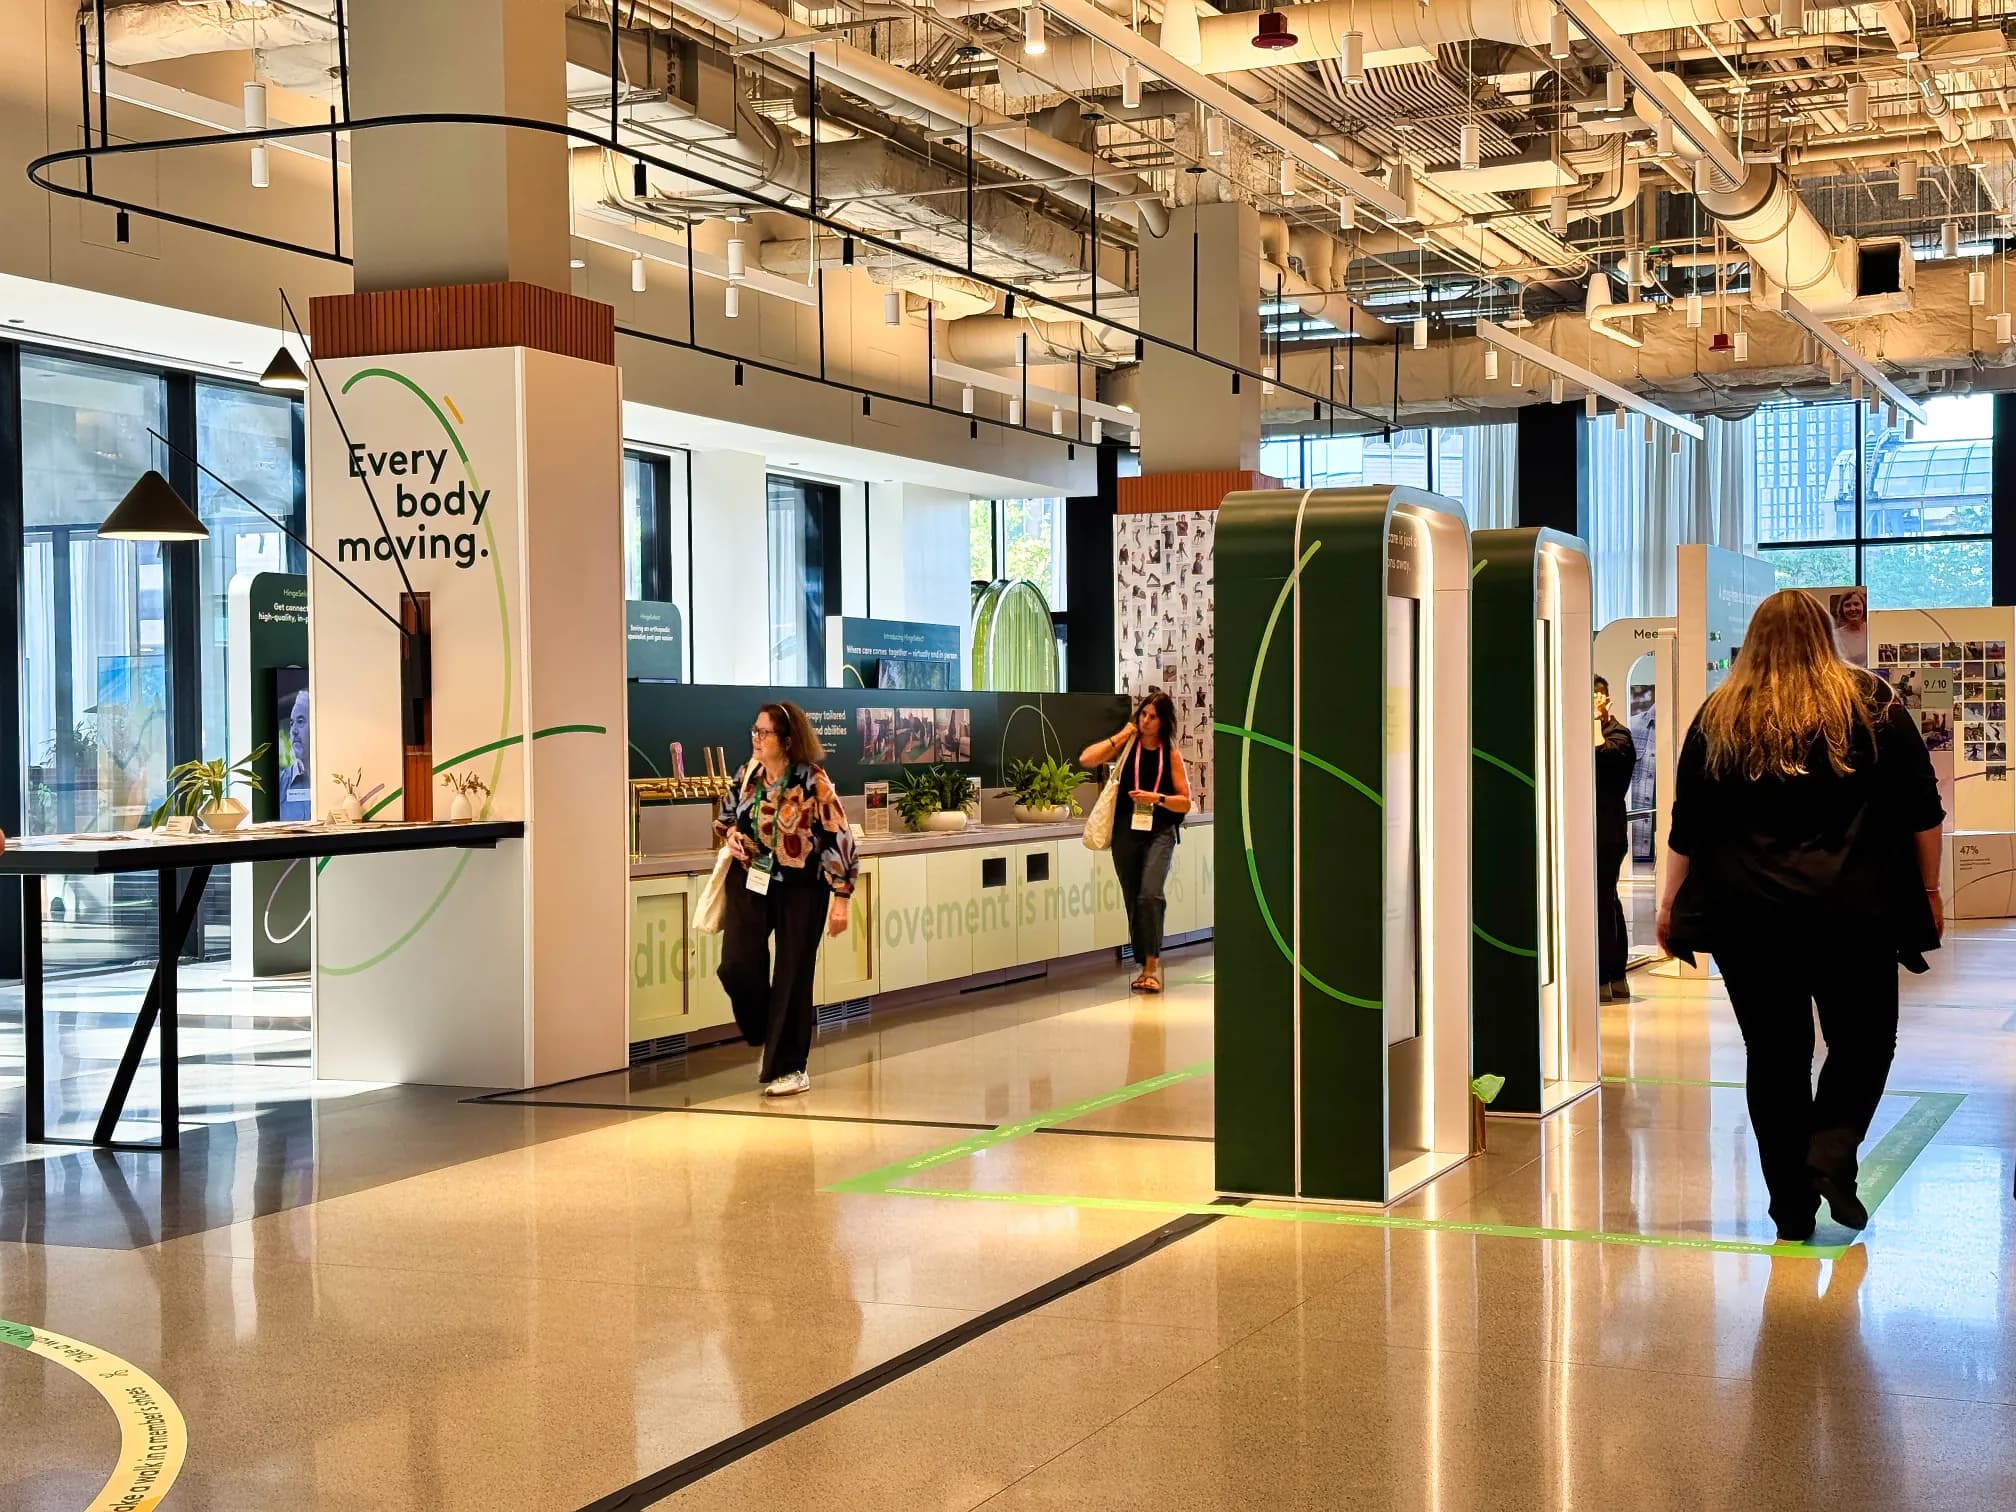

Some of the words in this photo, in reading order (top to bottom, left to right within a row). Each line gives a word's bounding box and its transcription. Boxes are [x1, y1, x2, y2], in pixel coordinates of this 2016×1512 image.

[349, 443, 448, 485] Every
[396, 480, 491, 525] body
[338, 523, 489, 569] moving.
[273, 602, 285, 611] Get
[1924, 680, 1929, 689] 9
[1938, 680, 1947, 688] 10
[823, 709, 846, 720] tailored
[824, 724, 847, 736] abilities
[1960, 846, 1980, 855] 47%
[851, 884, 1010, 954] Movement
[1019, 876, 1036, 927] is
[1448, 1224, 1493, 1232] path
[1591, 1234, 1664, 1246] Choose
[1667, 1240, 1711, 1250] your
[1714, 1242, 1763, 1253] path
[125, 1386, 156, 1407] shoes
[134, 1406, 168, 1444] member's
[138, 1452, 166, 1462] in
[131, 1461, 164, 1484] walk
